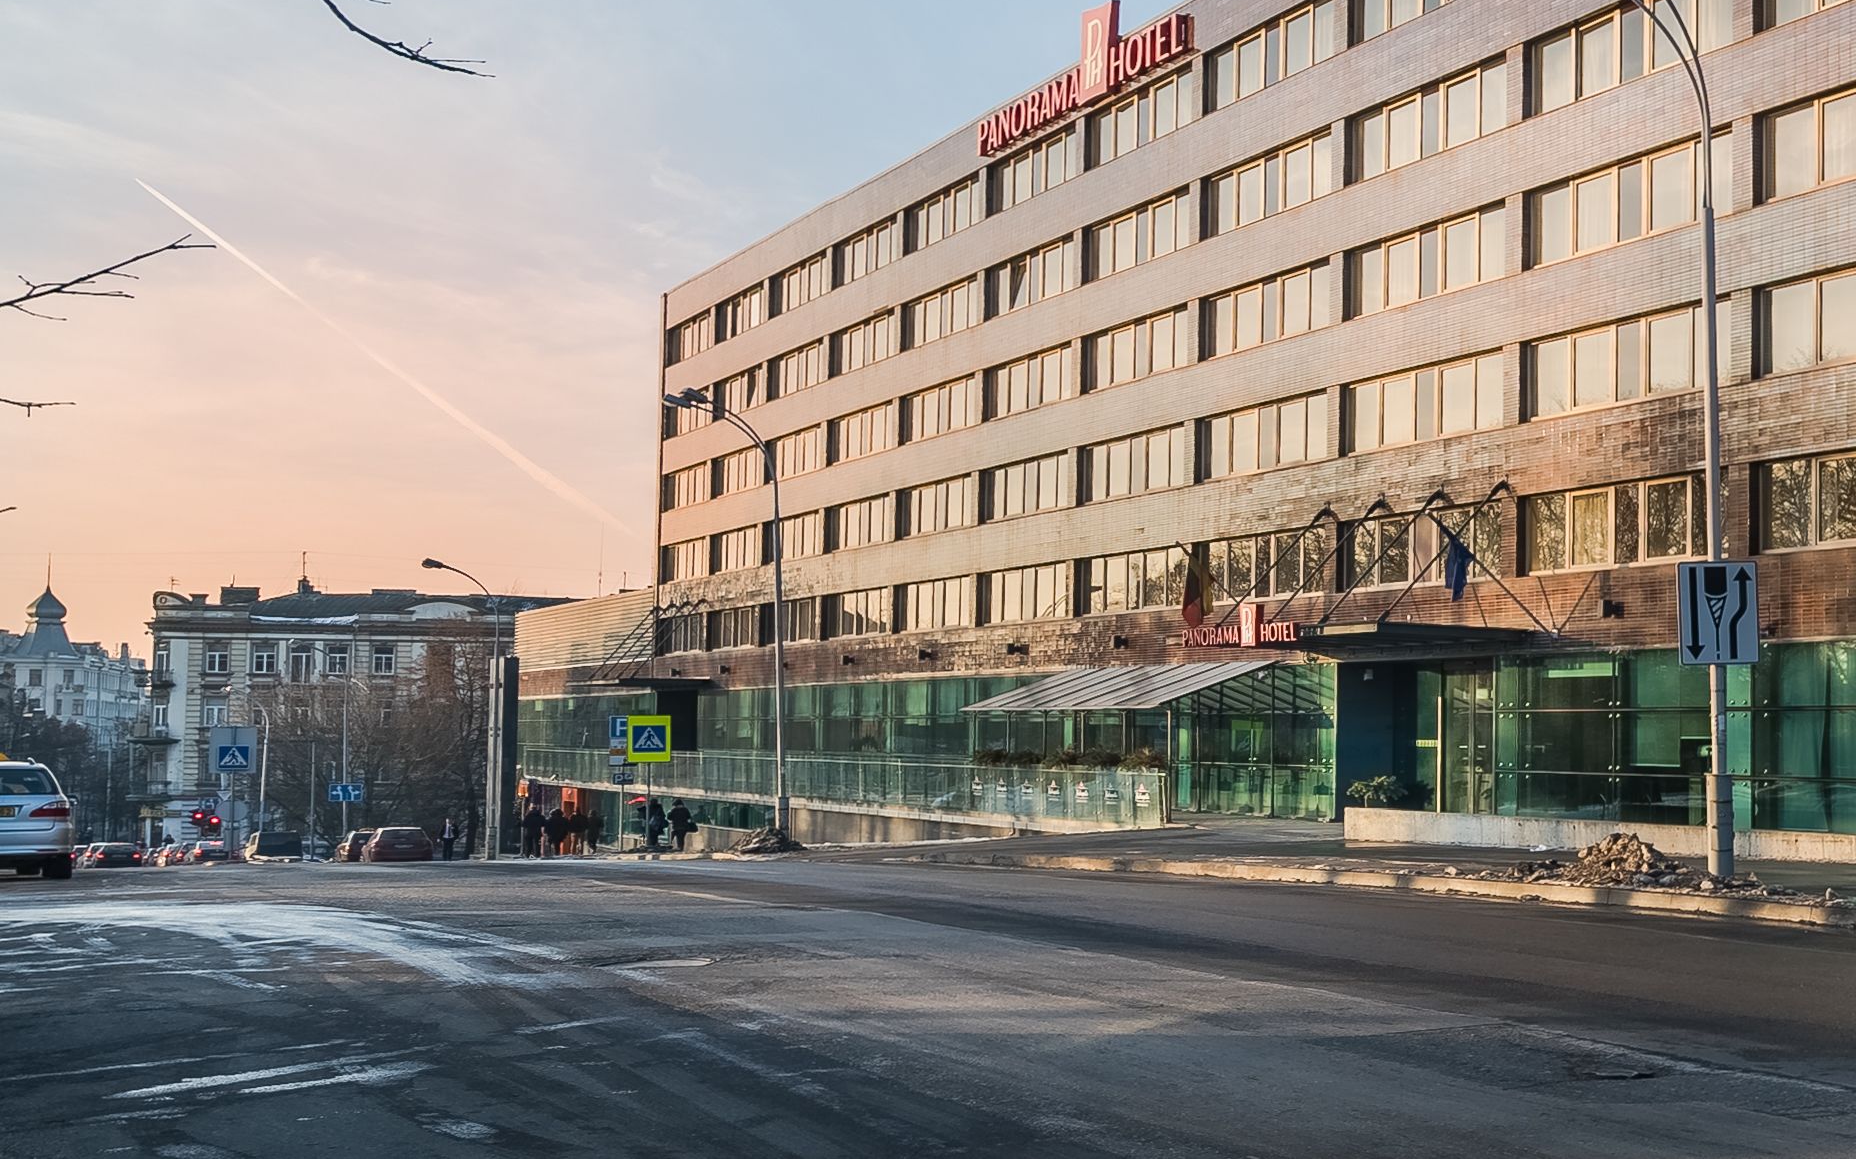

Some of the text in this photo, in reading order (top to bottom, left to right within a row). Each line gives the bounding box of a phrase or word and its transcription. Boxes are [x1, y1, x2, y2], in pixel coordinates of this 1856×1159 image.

[977, 69, 1082, 156] PANORAMA
[1109, 14, 1185, 86] HOTEL
[1182, 626, 1239, 647] PANORAMA
[1260, 622, 1297, 642] HOTEL
